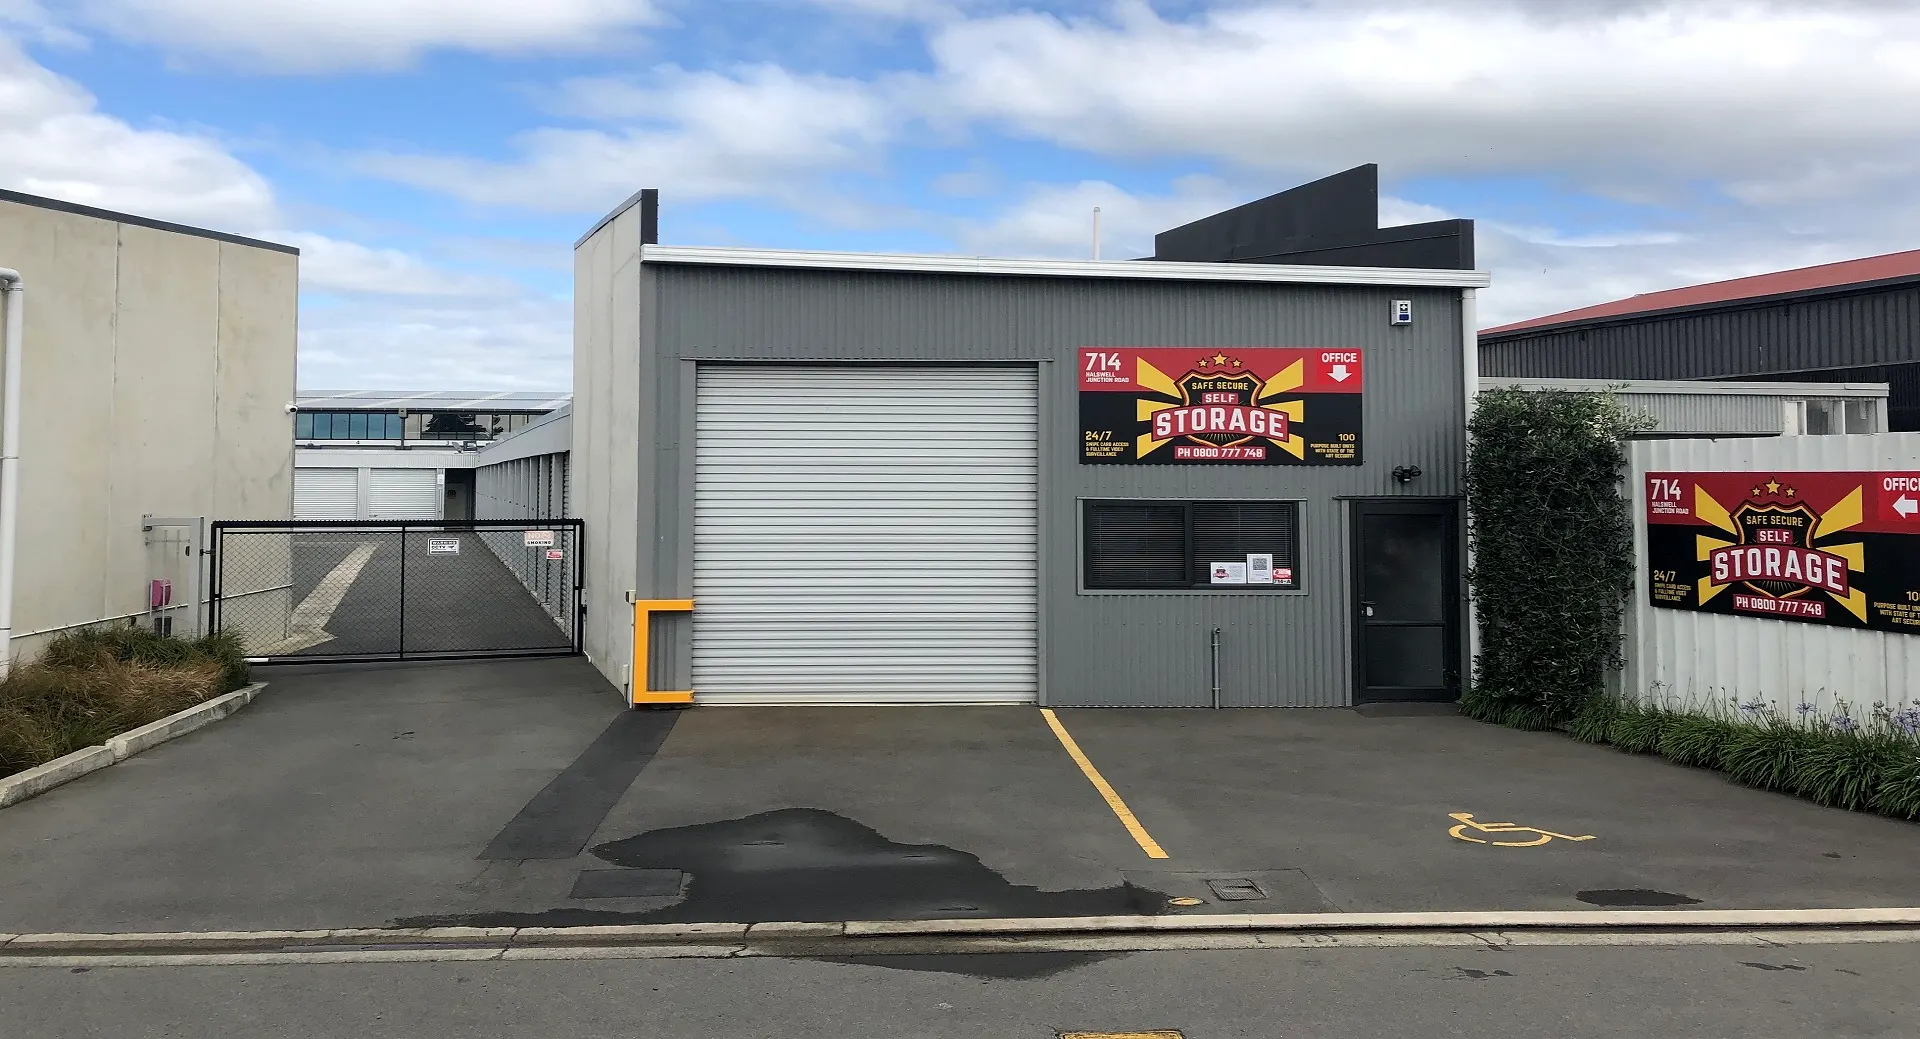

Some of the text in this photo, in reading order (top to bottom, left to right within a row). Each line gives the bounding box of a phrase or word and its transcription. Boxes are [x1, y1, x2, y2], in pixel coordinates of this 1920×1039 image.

[1085, 352, 1121, 371] 714
[1321, 353, 1357, 363] OFFICE
[1192, 382, 1249, 391] SAFE SECURE
[1205, 394, 1235, 403] SELF
[1156, 407, 1284, 438] STORAGE
[1085, 431, 1112, 441] 24/7
[1338, 433, 1356, 441] 100
[1177, 448, 1263, 458] PH 0800 777 748
[1650, 479, 1682, 500] 714
[1883, 477, 1920, 491] OFFIC
[1746, 515, 1803, 527] SAFE SECURE
[1759, 530, 1789, 543] SELF
[1715, 548, 1843, 591] STORAGE
[1654, 569, 1676, 582] 24/7
[1906, 591, 1920, 601] 10
[1736, 597, 1822, 615] PH 0800 777 748
[1873, 601, 1896, 609] PURPOSE
[1893, 610, 1908, 618] STATE
